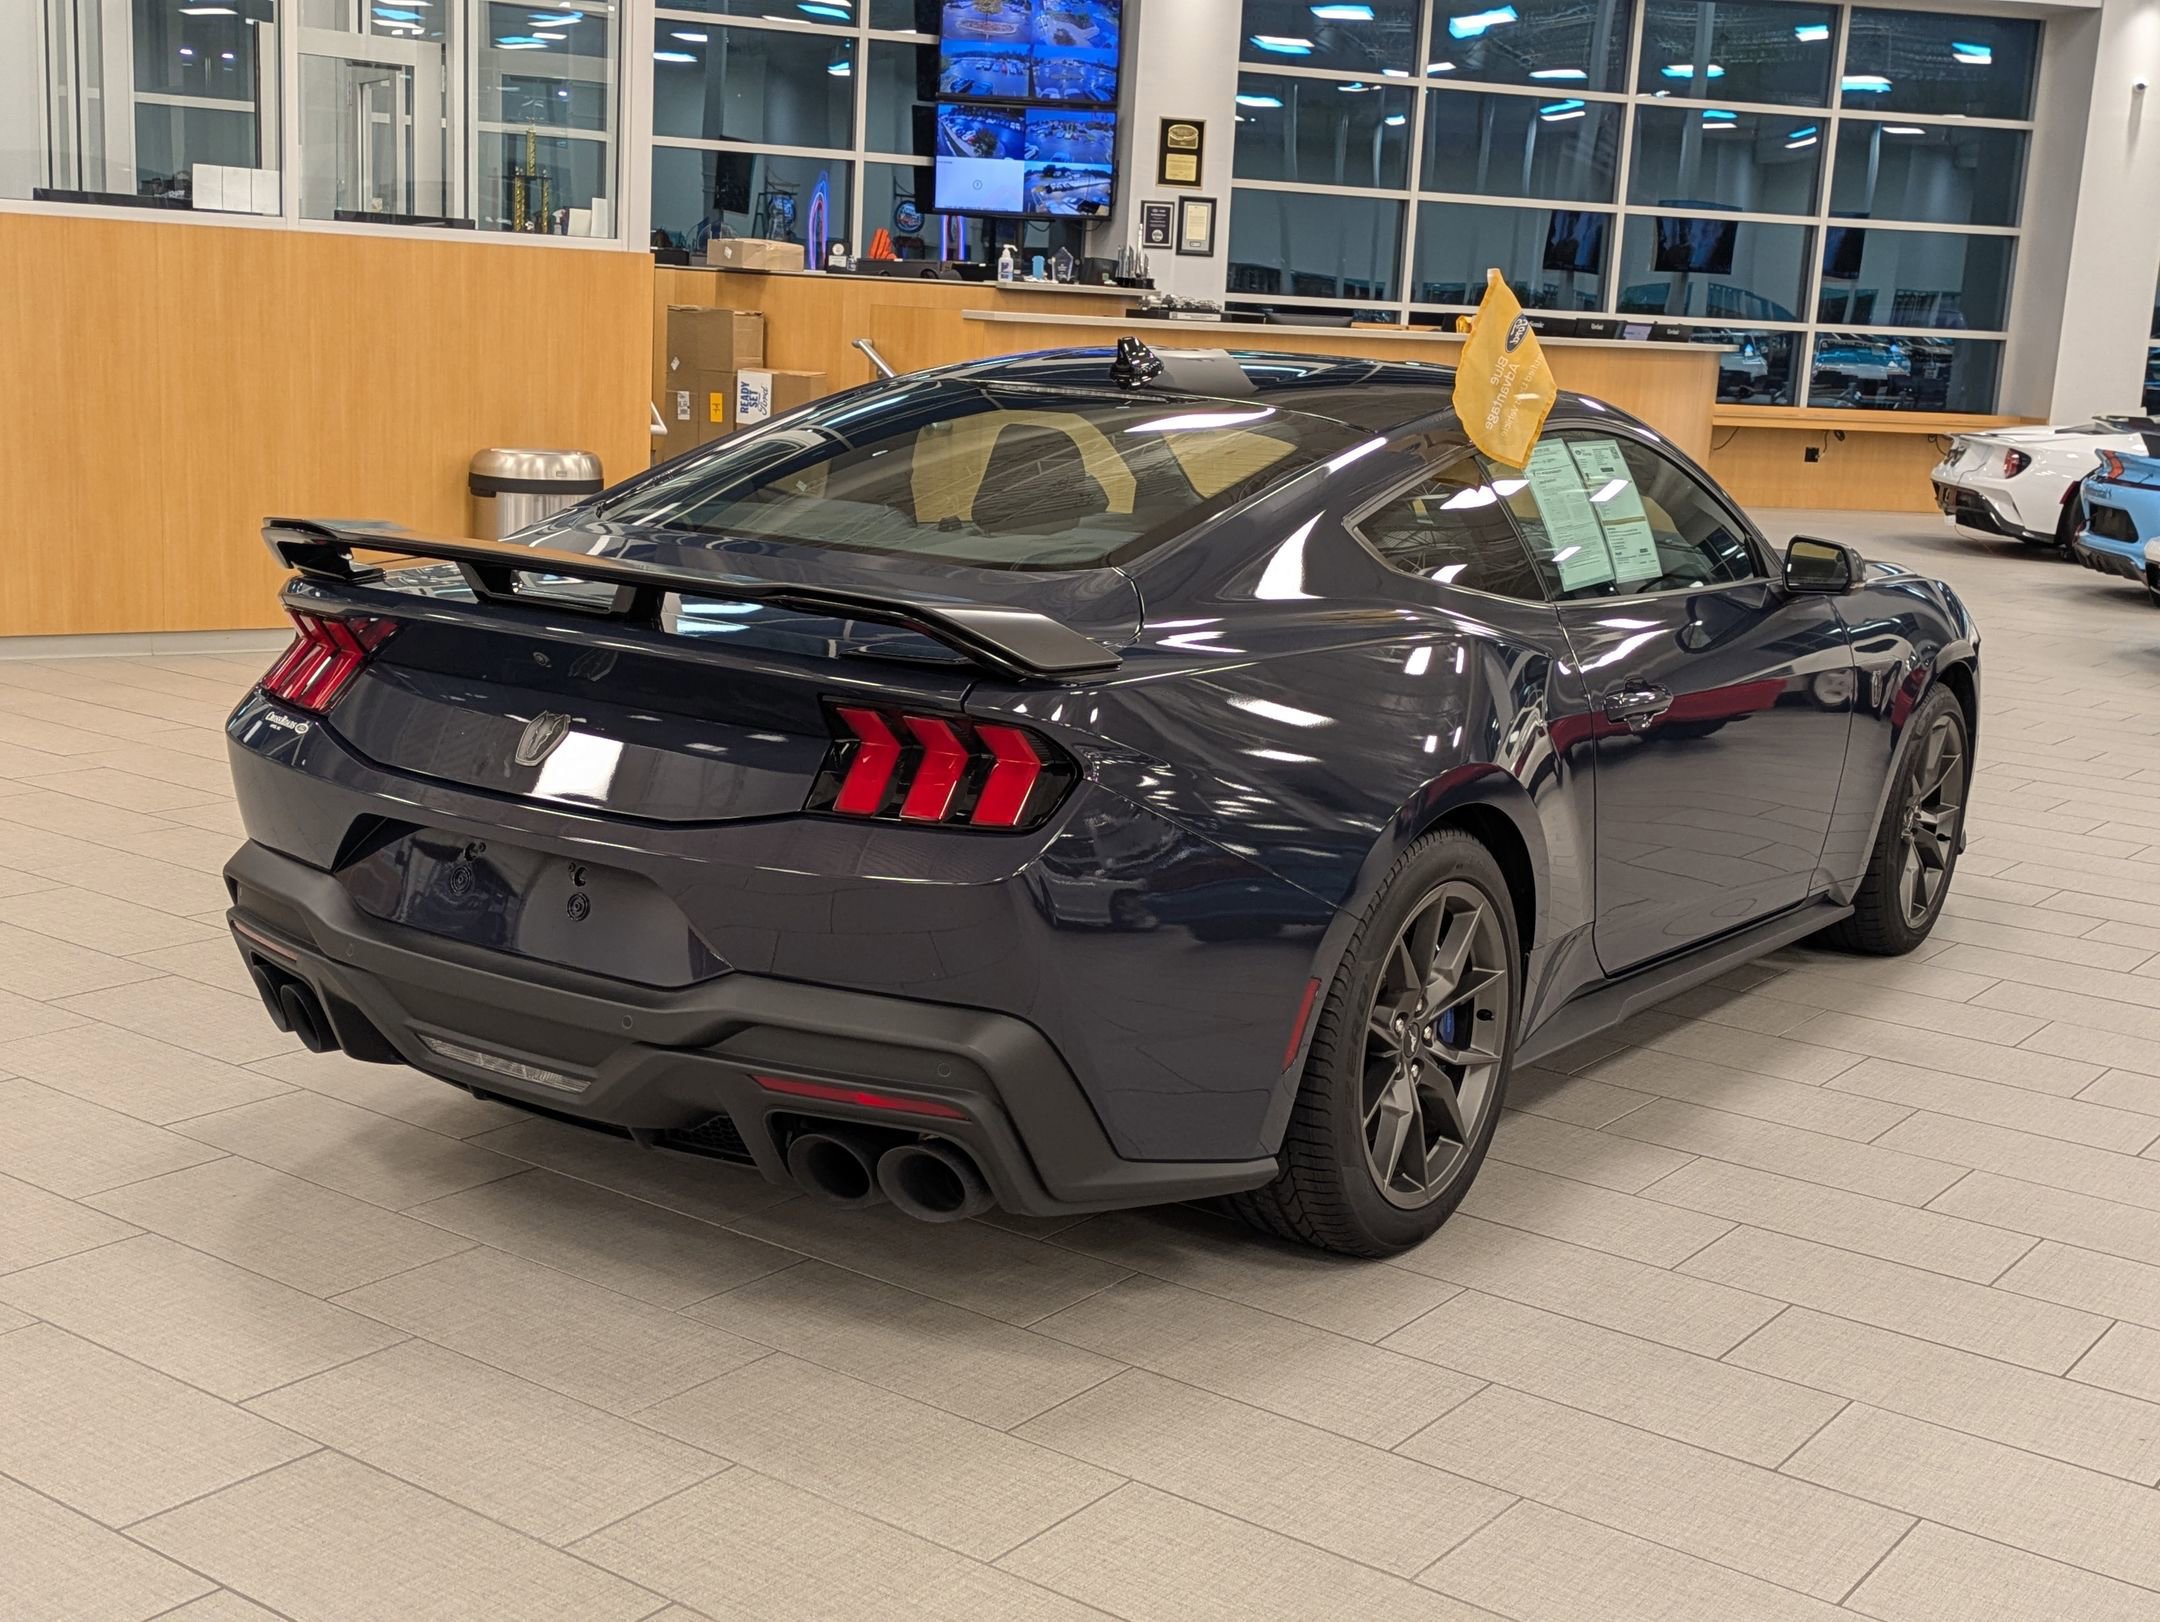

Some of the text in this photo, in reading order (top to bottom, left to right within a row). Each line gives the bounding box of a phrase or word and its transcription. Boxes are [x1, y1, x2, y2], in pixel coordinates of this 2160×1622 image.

[740, 381, 749, 414] READY
[749, 391, 759, 408] SET
[758, 386, 768, 415] Ford
